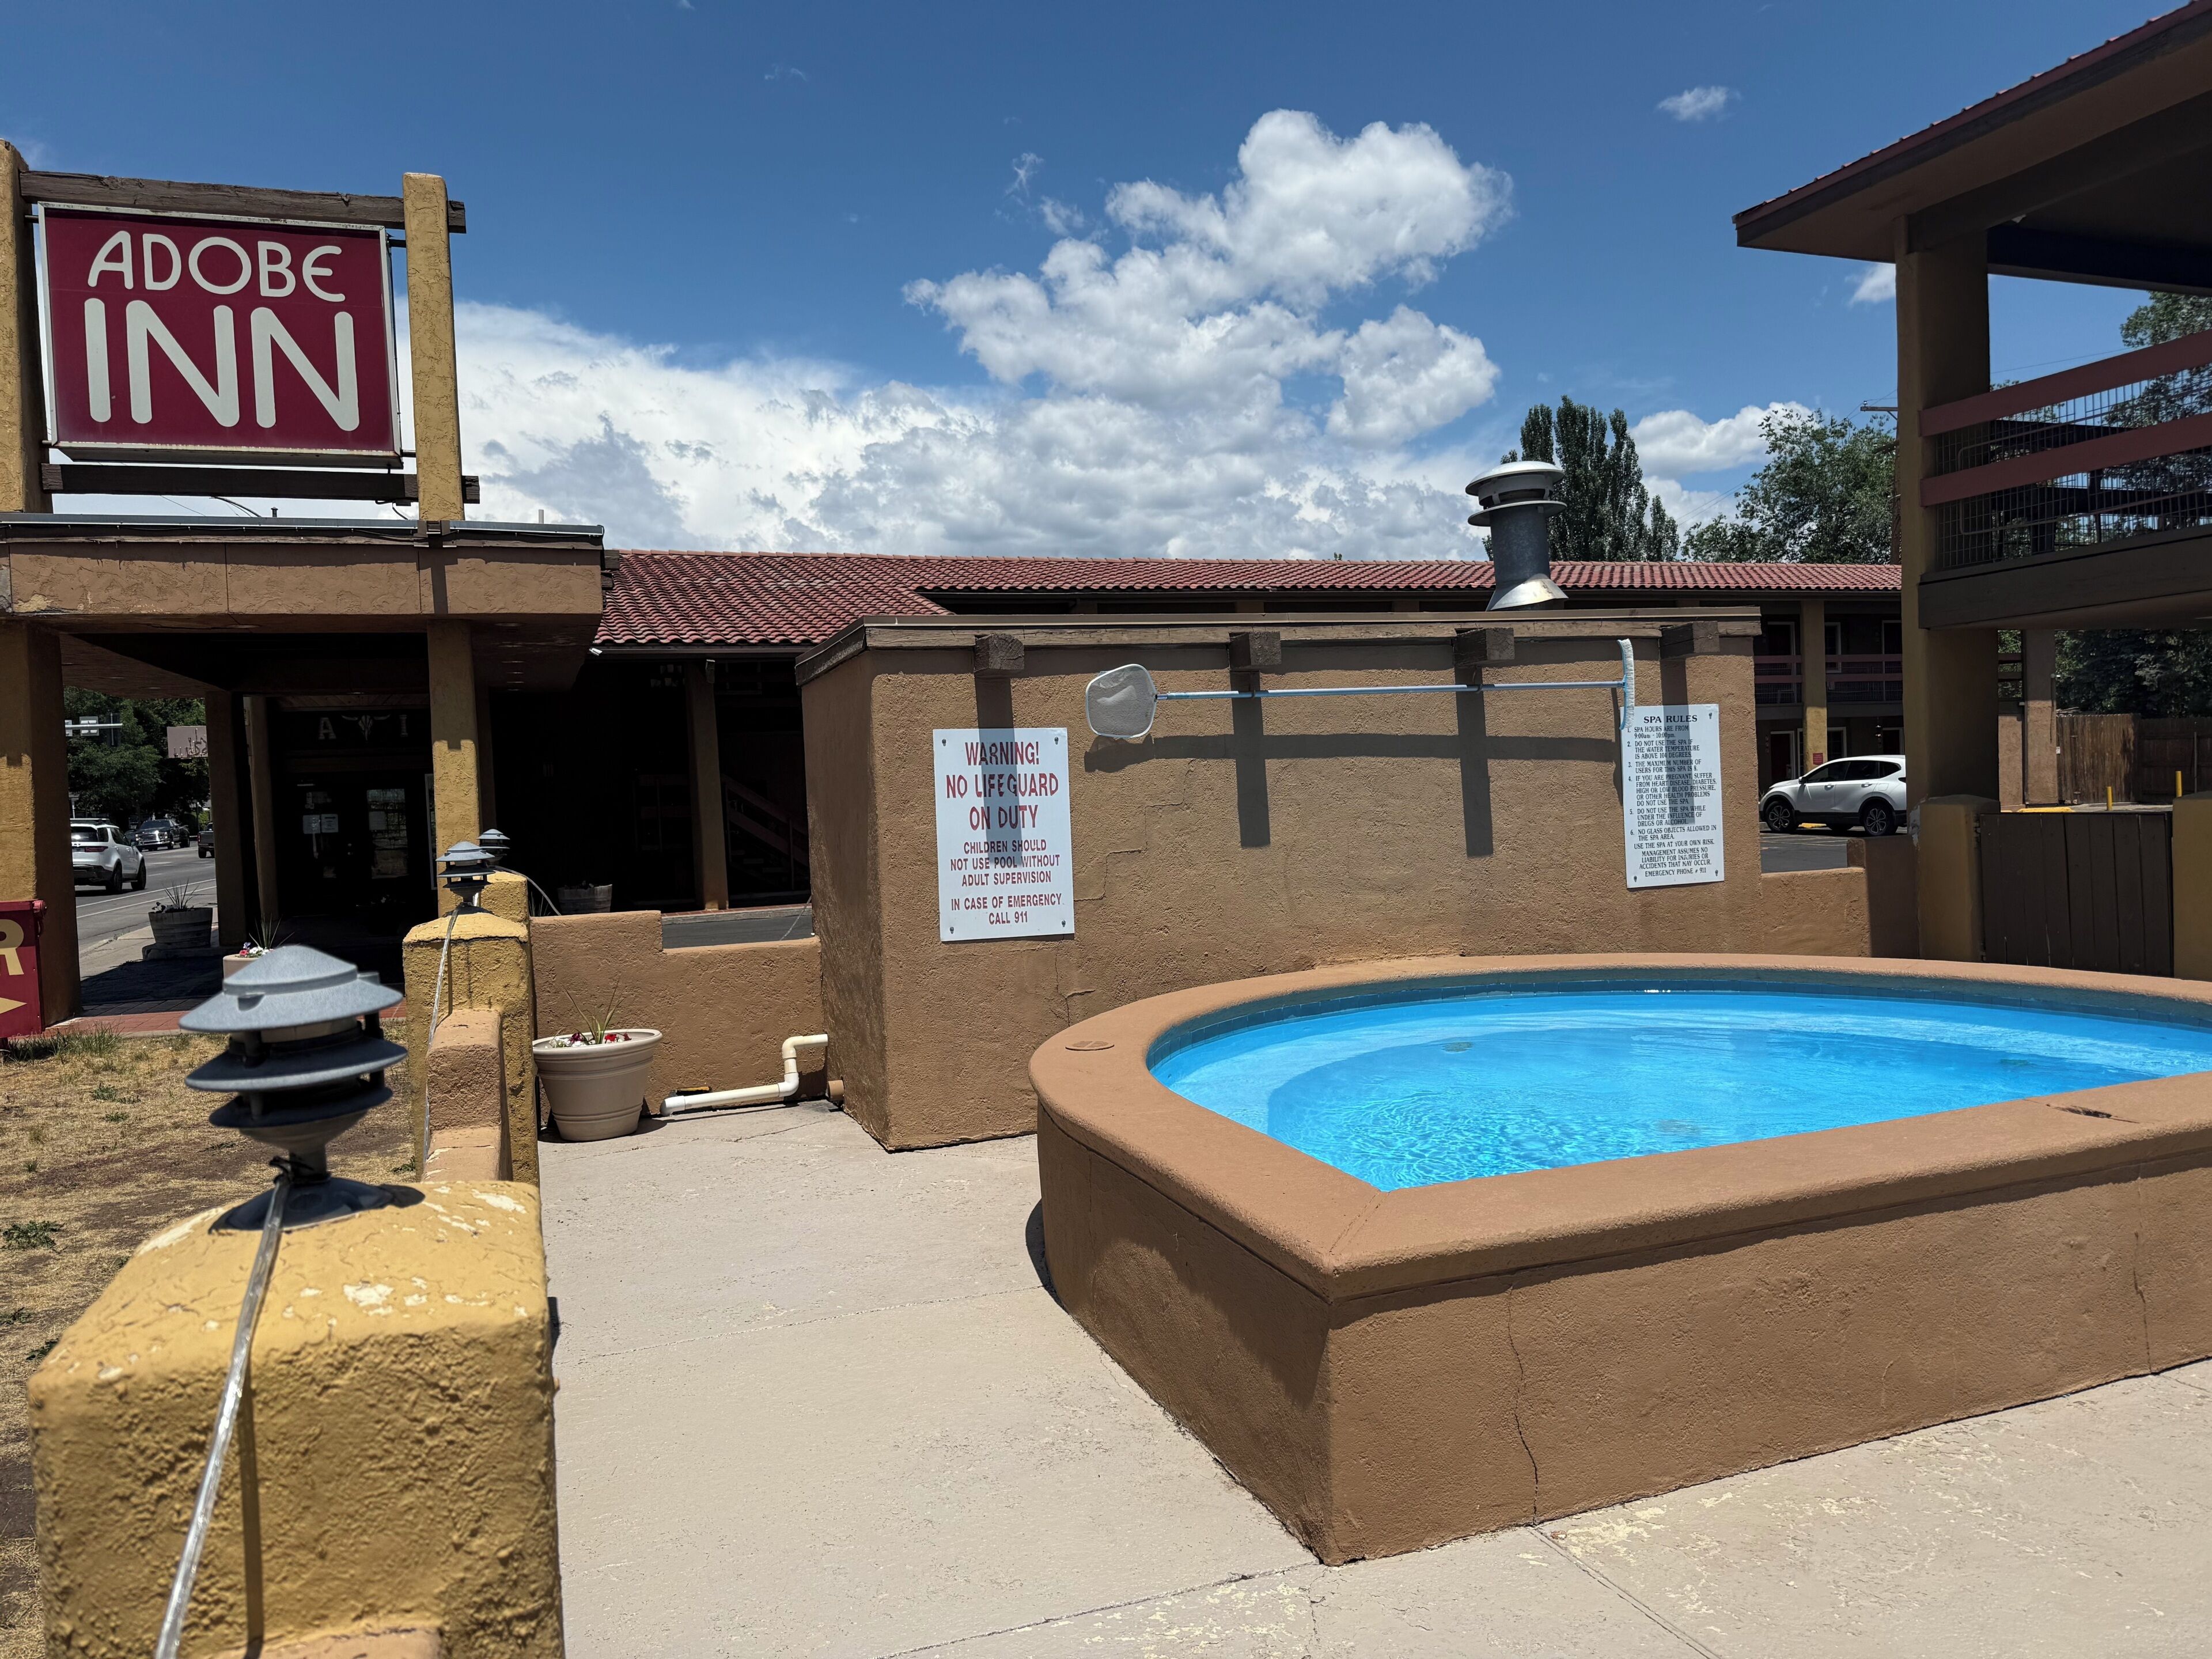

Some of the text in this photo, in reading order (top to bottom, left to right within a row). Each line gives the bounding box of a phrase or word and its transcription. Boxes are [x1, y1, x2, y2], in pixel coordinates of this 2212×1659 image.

[88, 230, 346, 302] ADOBE
[84, 298, 360, 431] INN
[318, 717, 336, 740] A
[965, 741, 1039, 766] WARNING!
[946, 773, 1058, 798] NO LIFEGUARD
[969, 805, 1038, 831] ON DUTY
[964, 839, 1047, 854] CHILDREN SHOULD
[950, 855, 1060, 871] NOT USE POOL WITHOUT
[962, 871, 1051, 887] ADULT SUPERVISION
[951, 893, 1062, 910] IN CASE OF EMERGENCY
[989, 911, 1027, 925] CALL 911
